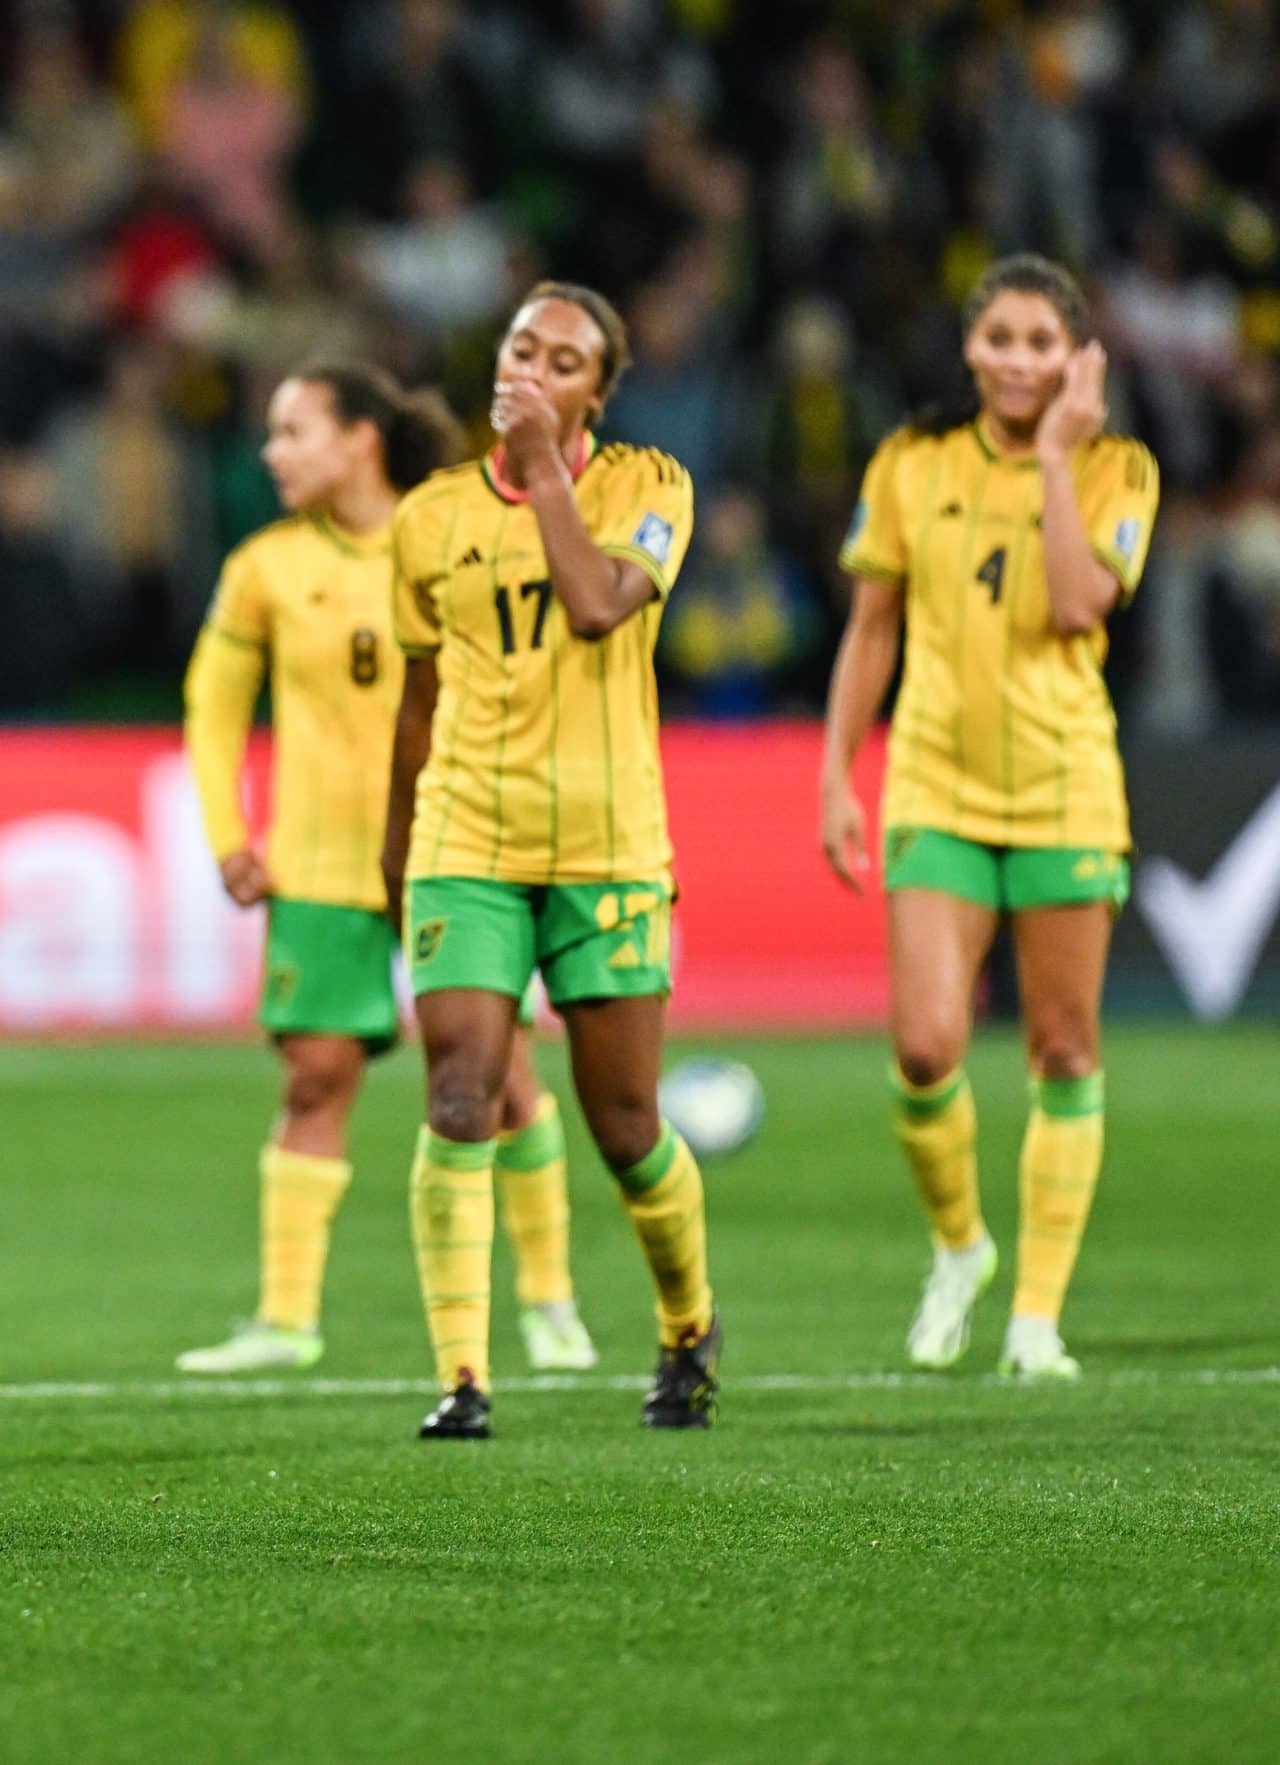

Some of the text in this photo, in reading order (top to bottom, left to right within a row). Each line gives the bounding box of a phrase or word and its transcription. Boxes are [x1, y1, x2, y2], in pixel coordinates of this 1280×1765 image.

[977, 546, 1008, 604] 4
[495, 580, 551, 655] 17
[351, 627, 378, 687] 8
